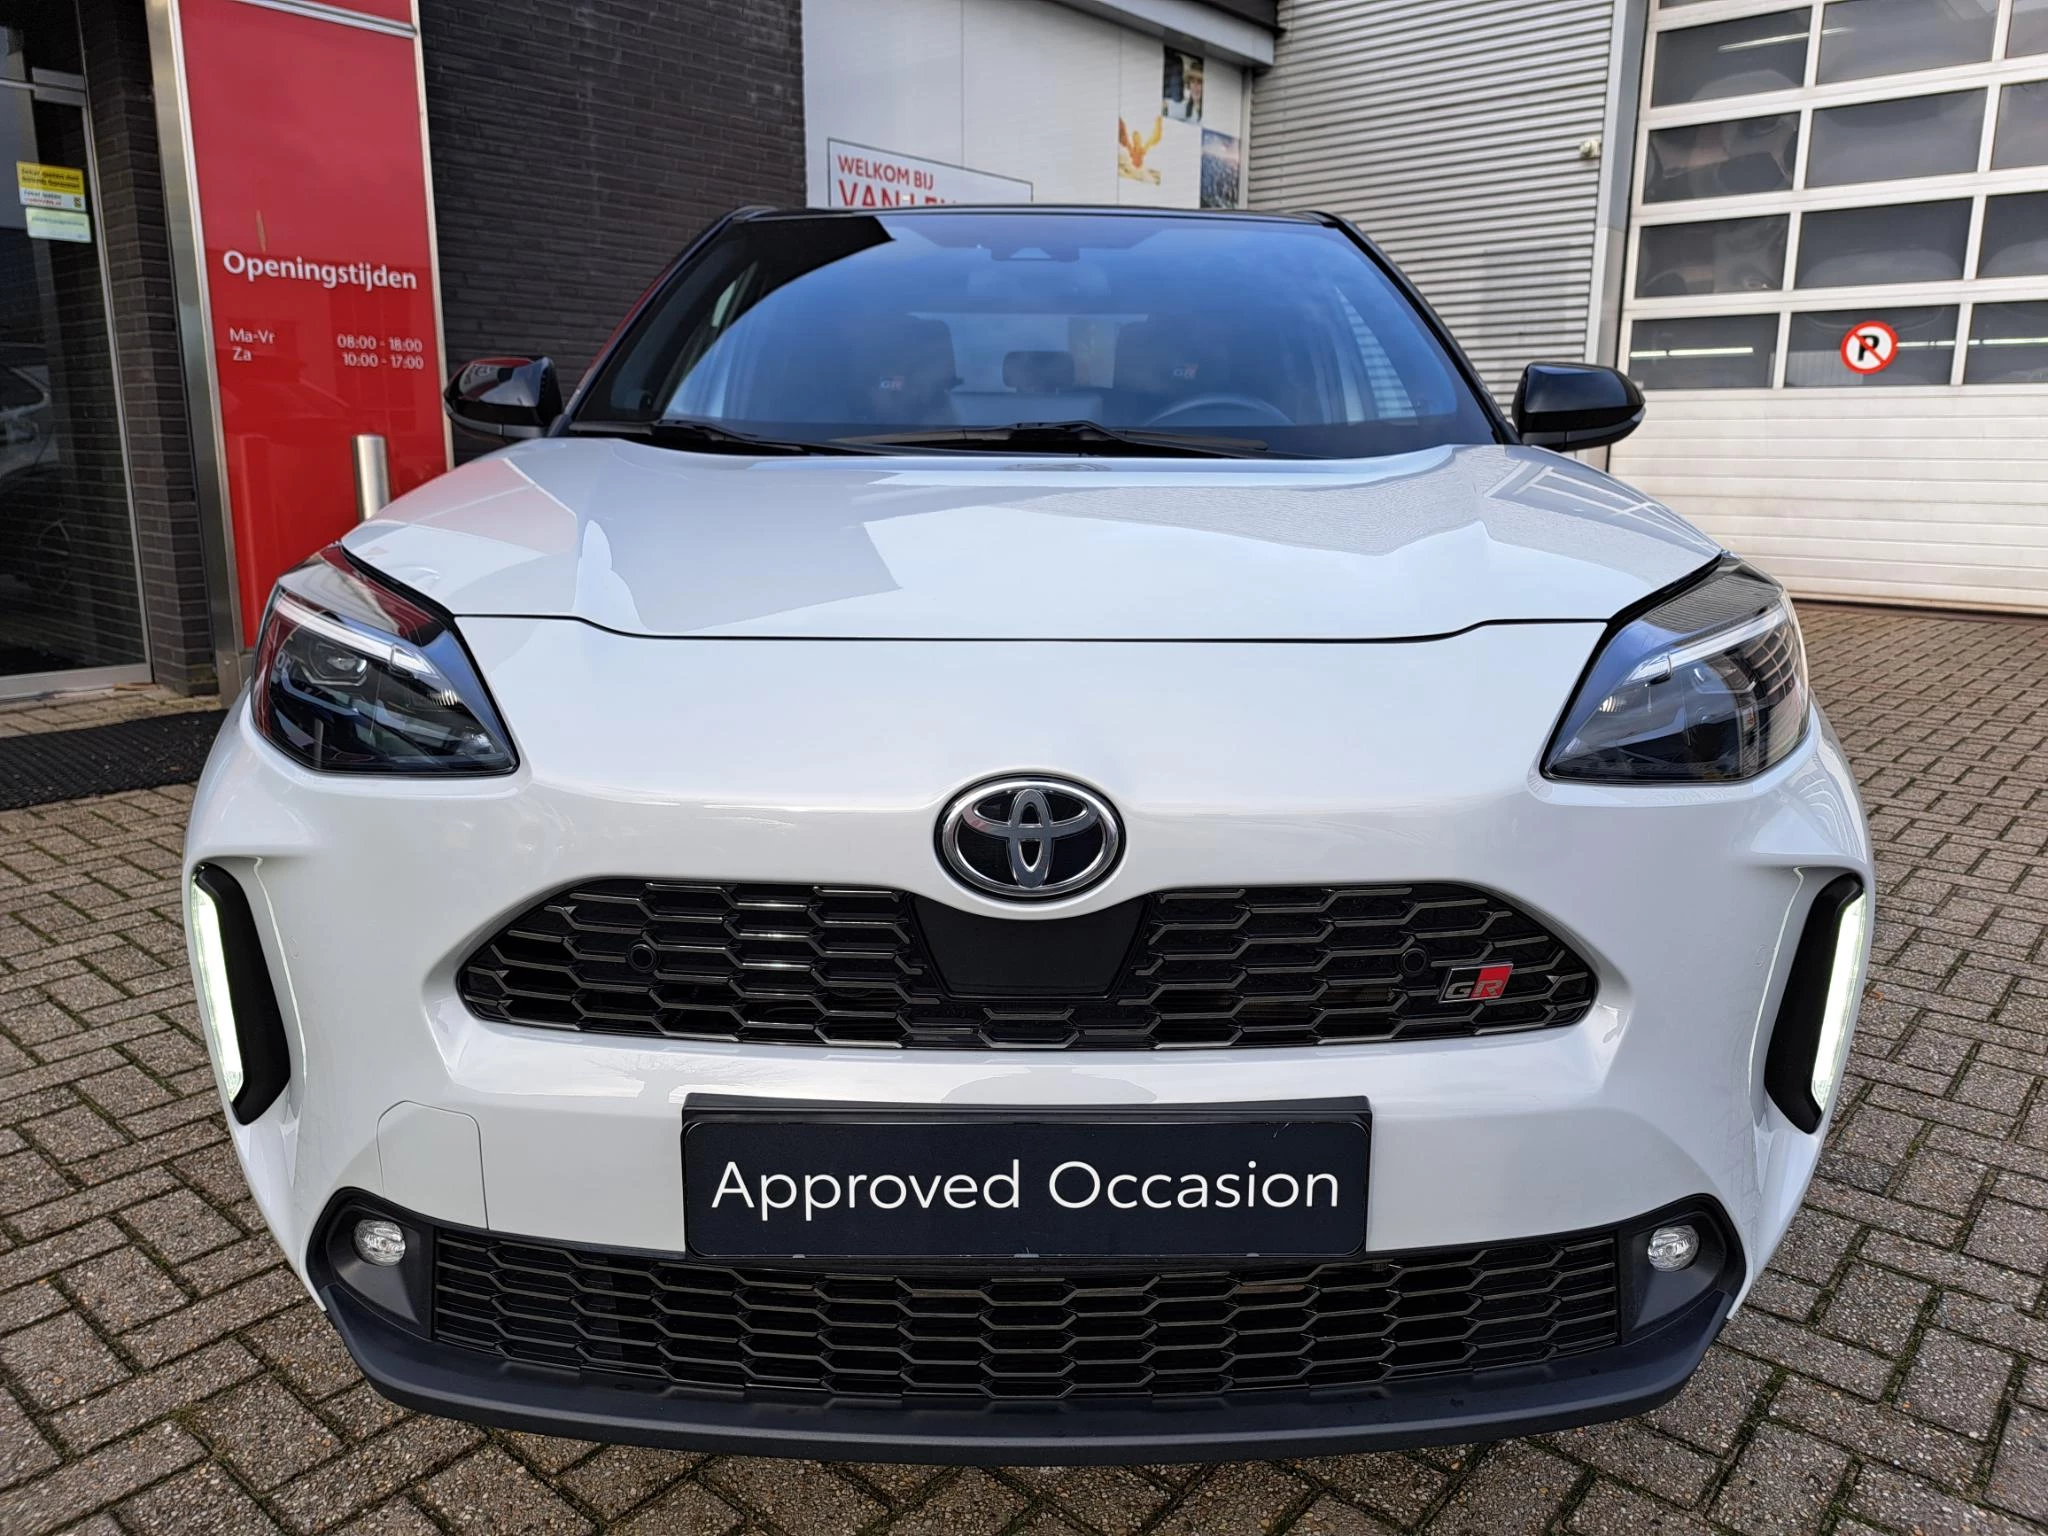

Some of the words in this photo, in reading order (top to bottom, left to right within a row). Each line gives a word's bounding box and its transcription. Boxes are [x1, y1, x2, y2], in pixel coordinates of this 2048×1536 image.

[837, 155, 910, 186] WELKOM
[914, 172, 934, 191] BIJ
[223, 250, 418, 291] Openingstijden
[229, 328, 276, 344] Ma-Vr
[337, 335, 377, 350] 08:00
[389, 337, 423, 352] 18:00
[233, 347, 252, 361] Za
[343, 353, 378, 367] 10:00
[391, 355, 424, 369] 17:00
[1444, 980, 1503, 999] GR
[711, 1158, 1021, 1222] Approved
[1048, 1160, 1339, 1209] Occasion
